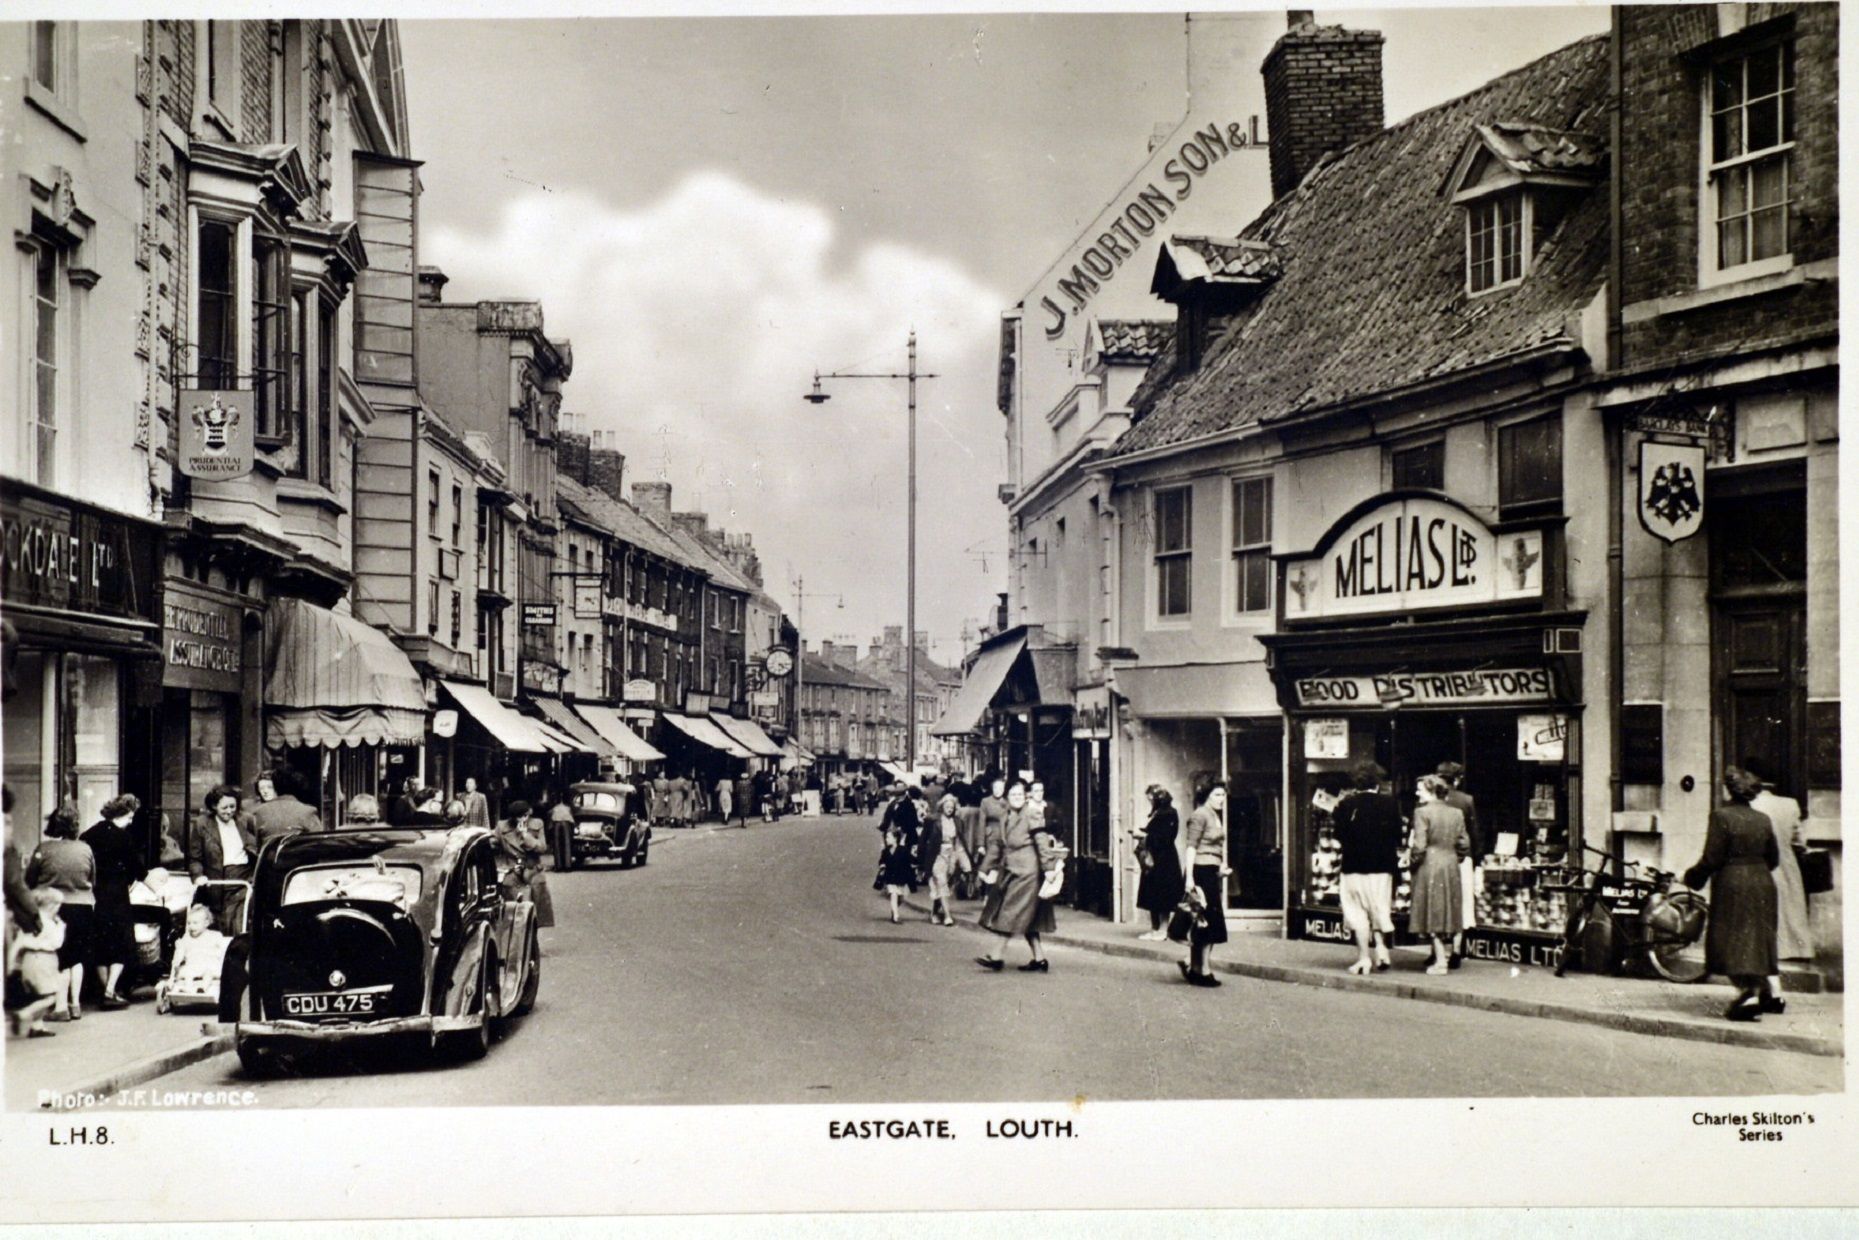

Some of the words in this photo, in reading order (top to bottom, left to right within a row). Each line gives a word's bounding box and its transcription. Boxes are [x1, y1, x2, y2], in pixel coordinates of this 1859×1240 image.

[1057, 183, 1176, 312] MORTON
[1164, 122, 1230, 201] SON
[188, 456, 241, 464] PRUDENTIAL
[188, 464, 241, 472] ASSURANCE
[1336, 515, 1446, 599] MELIAS
[1305, 919, 1352, 940] MELIAS
[1466, 938, 1522, 963] MELIAS
[287, 996, 328, 1014] CDU
[333, 994, 373, 1012] 475
